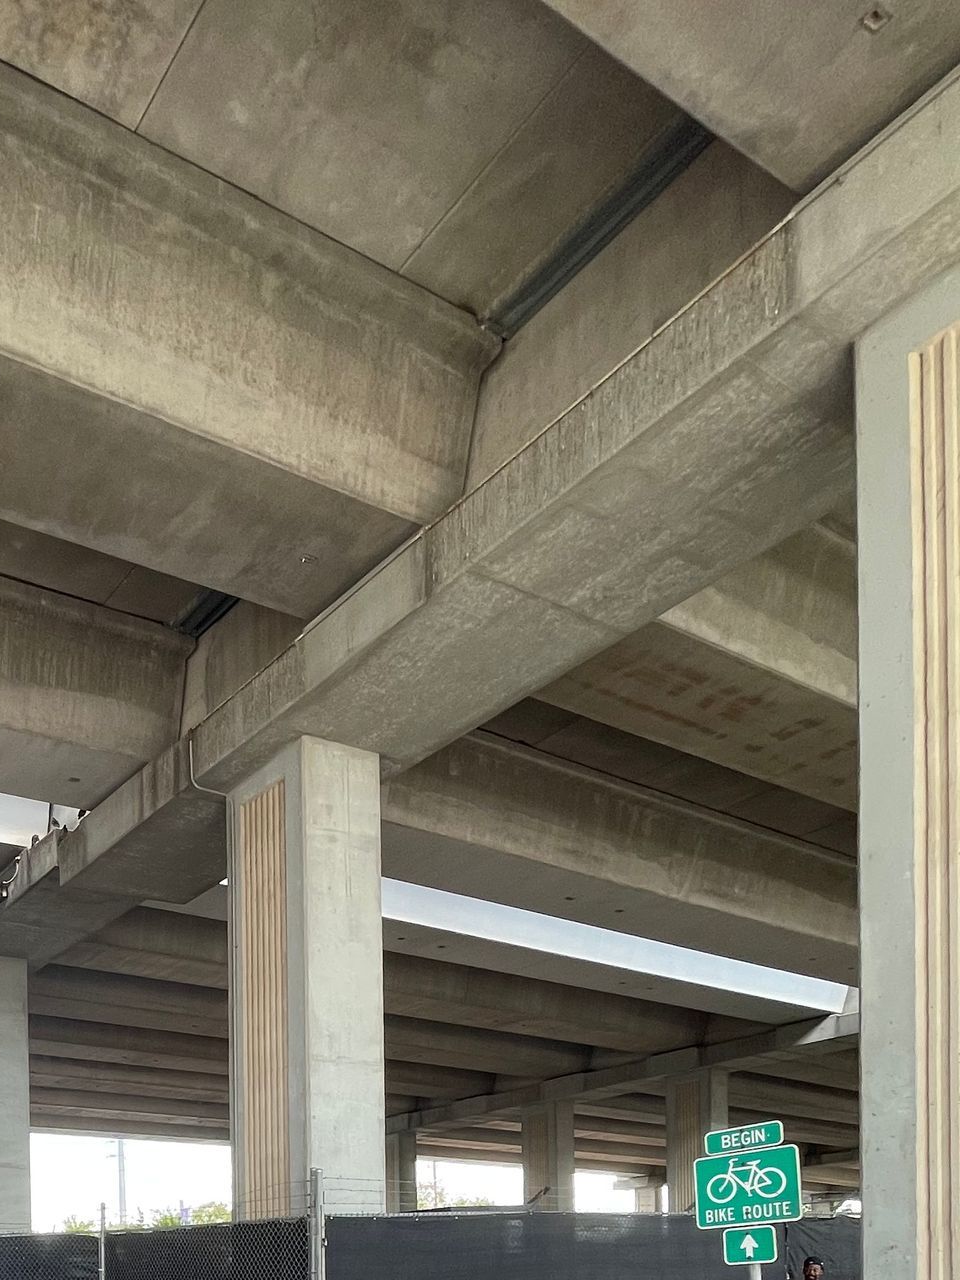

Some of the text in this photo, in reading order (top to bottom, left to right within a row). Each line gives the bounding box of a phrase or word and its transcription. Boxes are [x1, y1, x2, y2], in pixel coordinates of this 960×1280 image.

[721, 1128, 766, 1149] BEGIN
[705, 1201, 792, 1224] BIKE ROUTE
